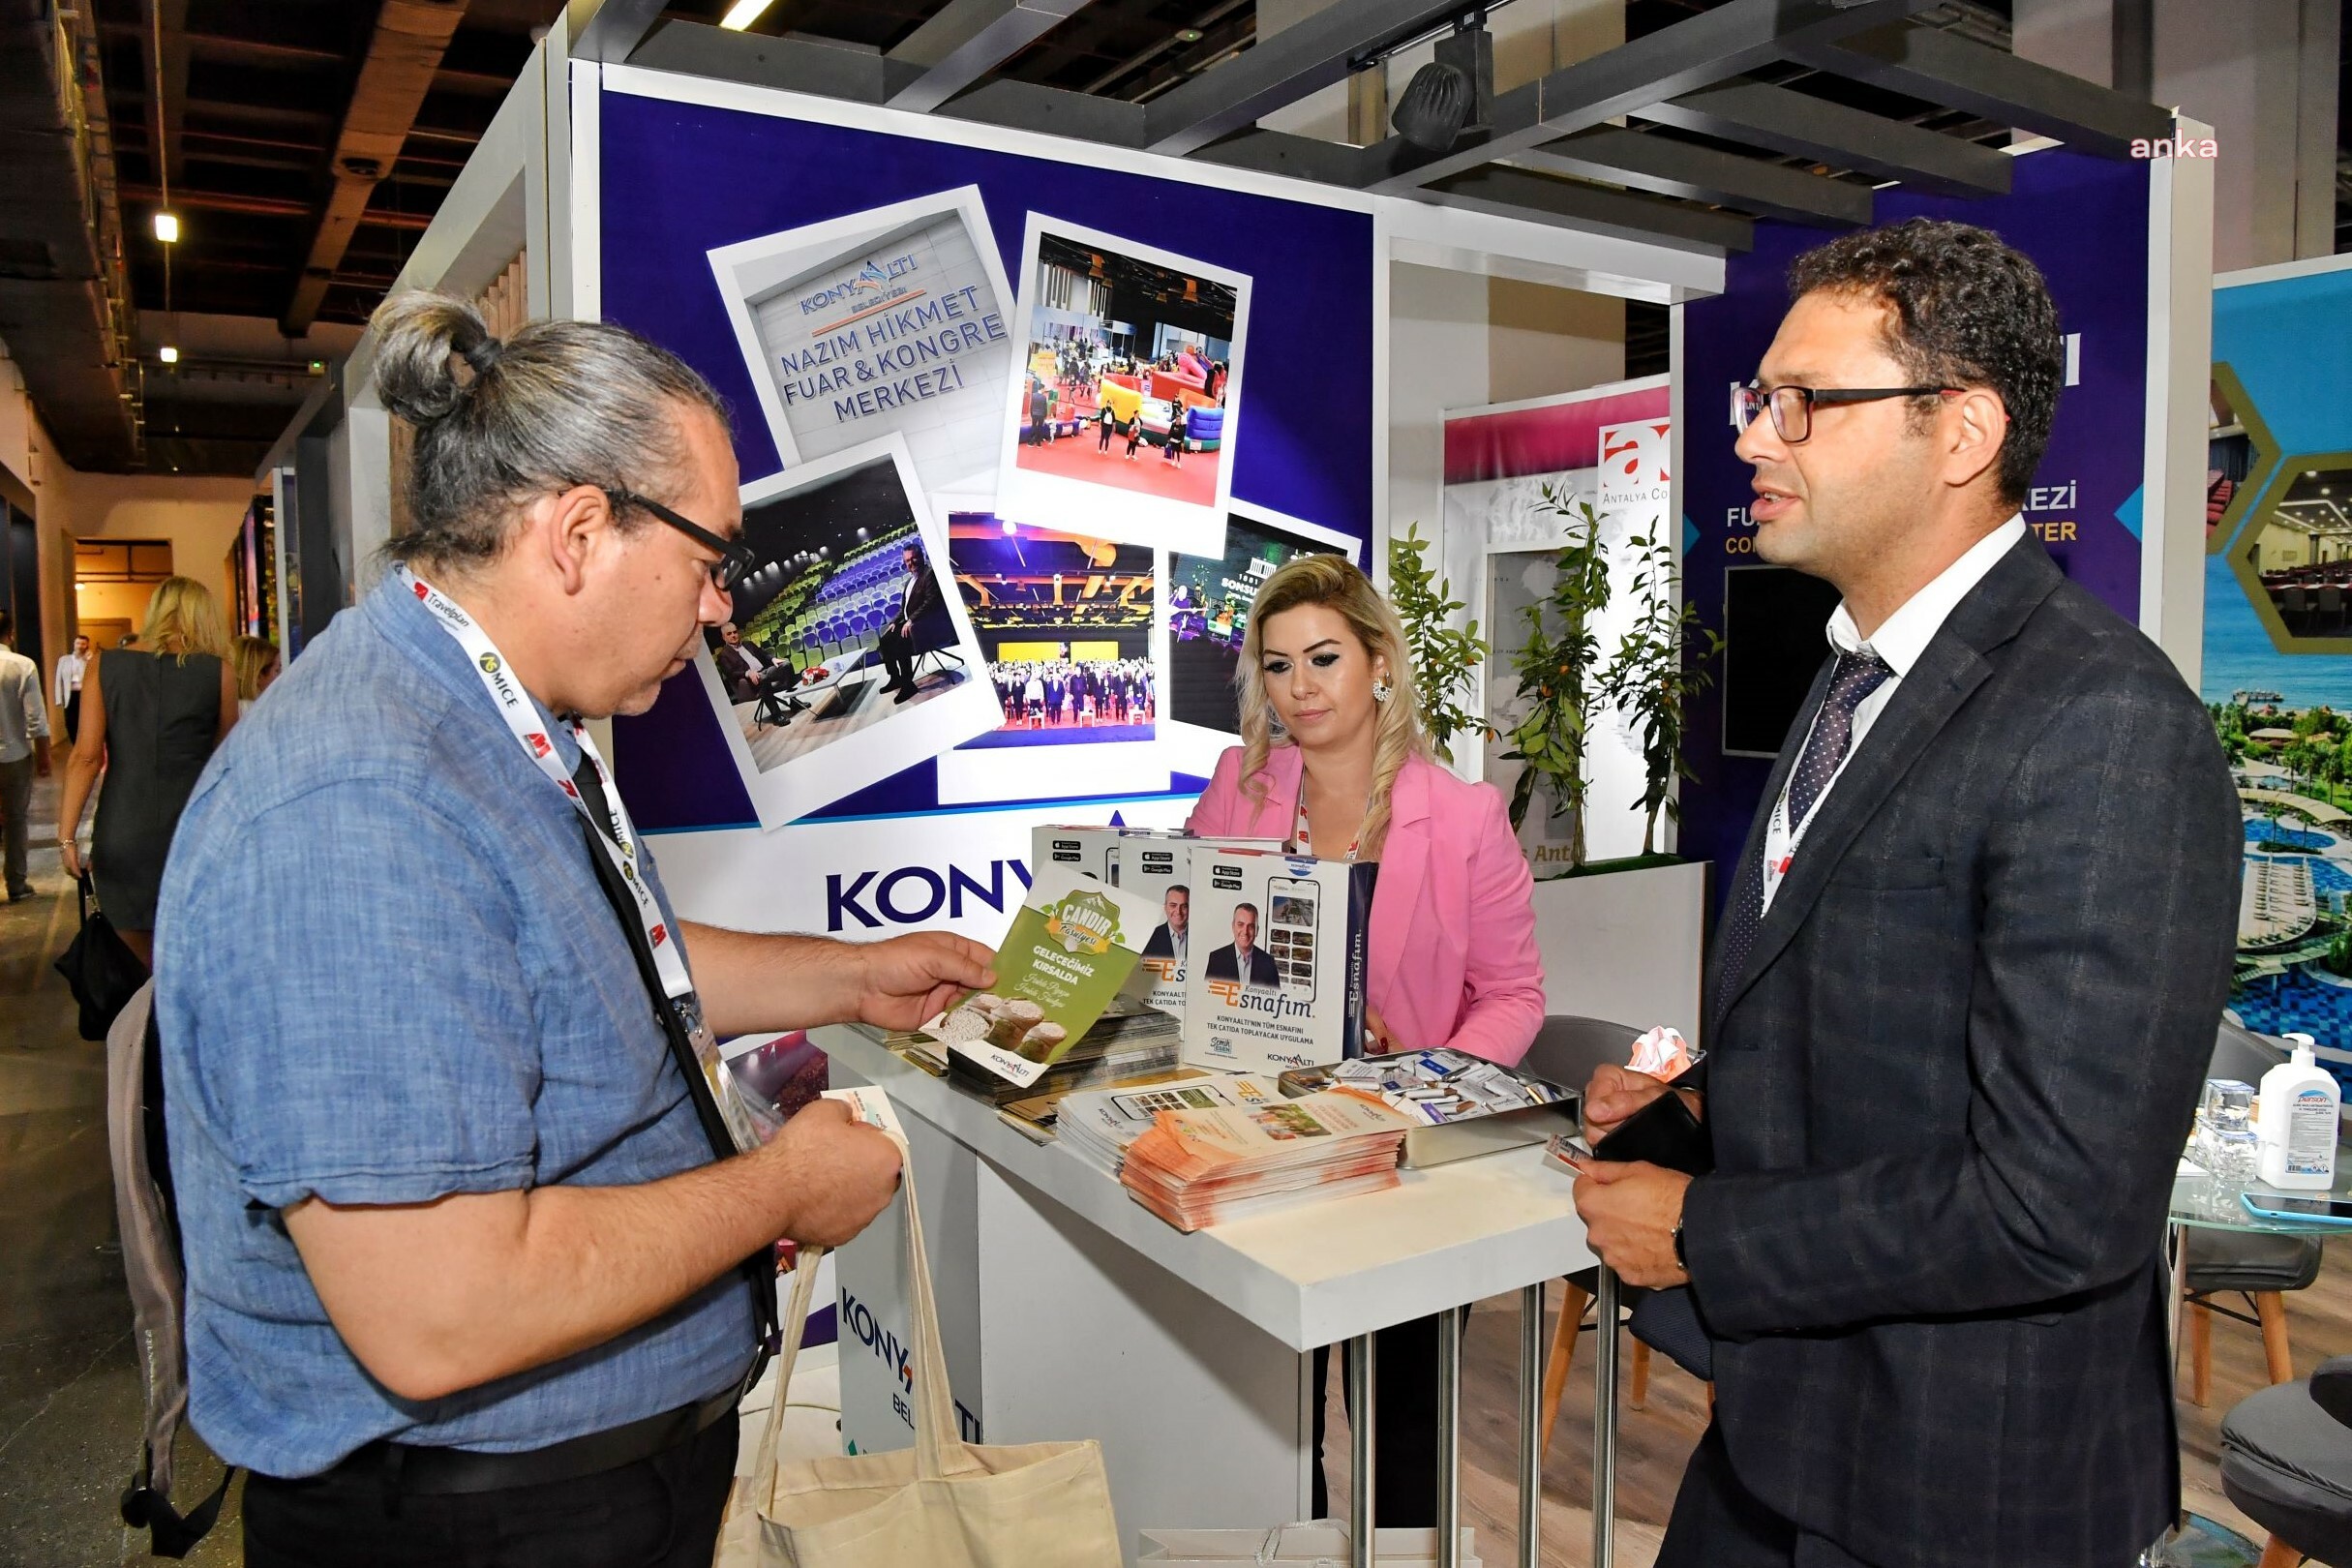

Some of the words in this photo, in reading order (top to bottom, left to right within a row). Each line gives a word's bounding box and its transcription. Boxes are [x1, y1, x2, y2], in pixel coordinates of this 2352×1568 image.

[799, 254, 918, 315] KONYAALTI
[780, 330, 860, 377] NAZIM
[865, 285, 980, 347] HİKMET
[833, 358, 965, 423] MERKEZİ
[2022, 479, 2077, 511] EZİ
[428, 592, 469, 627] Travelplan
[492, 672, 519, 709] MICE
[631, 879, 649, 908] MICE
[1032, 959, 1079, 985] KIRSALDA
[1033, 945, 1096, 978] GELECEĞİMİZ
[1207, 1022, 1218, 1031] TEK
[1218, 1024, 1240, 1035] ÇATIDA
[1241, 1027, 1280, 1040] TOPLAYACAK
[1280, 1034, 1313, 1045] UYGULAMA
[1261, 1021, 1276, 1031] TÜM
[1276, 1024, 1304, 1035] ESNAFINI
[1267, 1053, 1314, 1067] KONYAALTI
